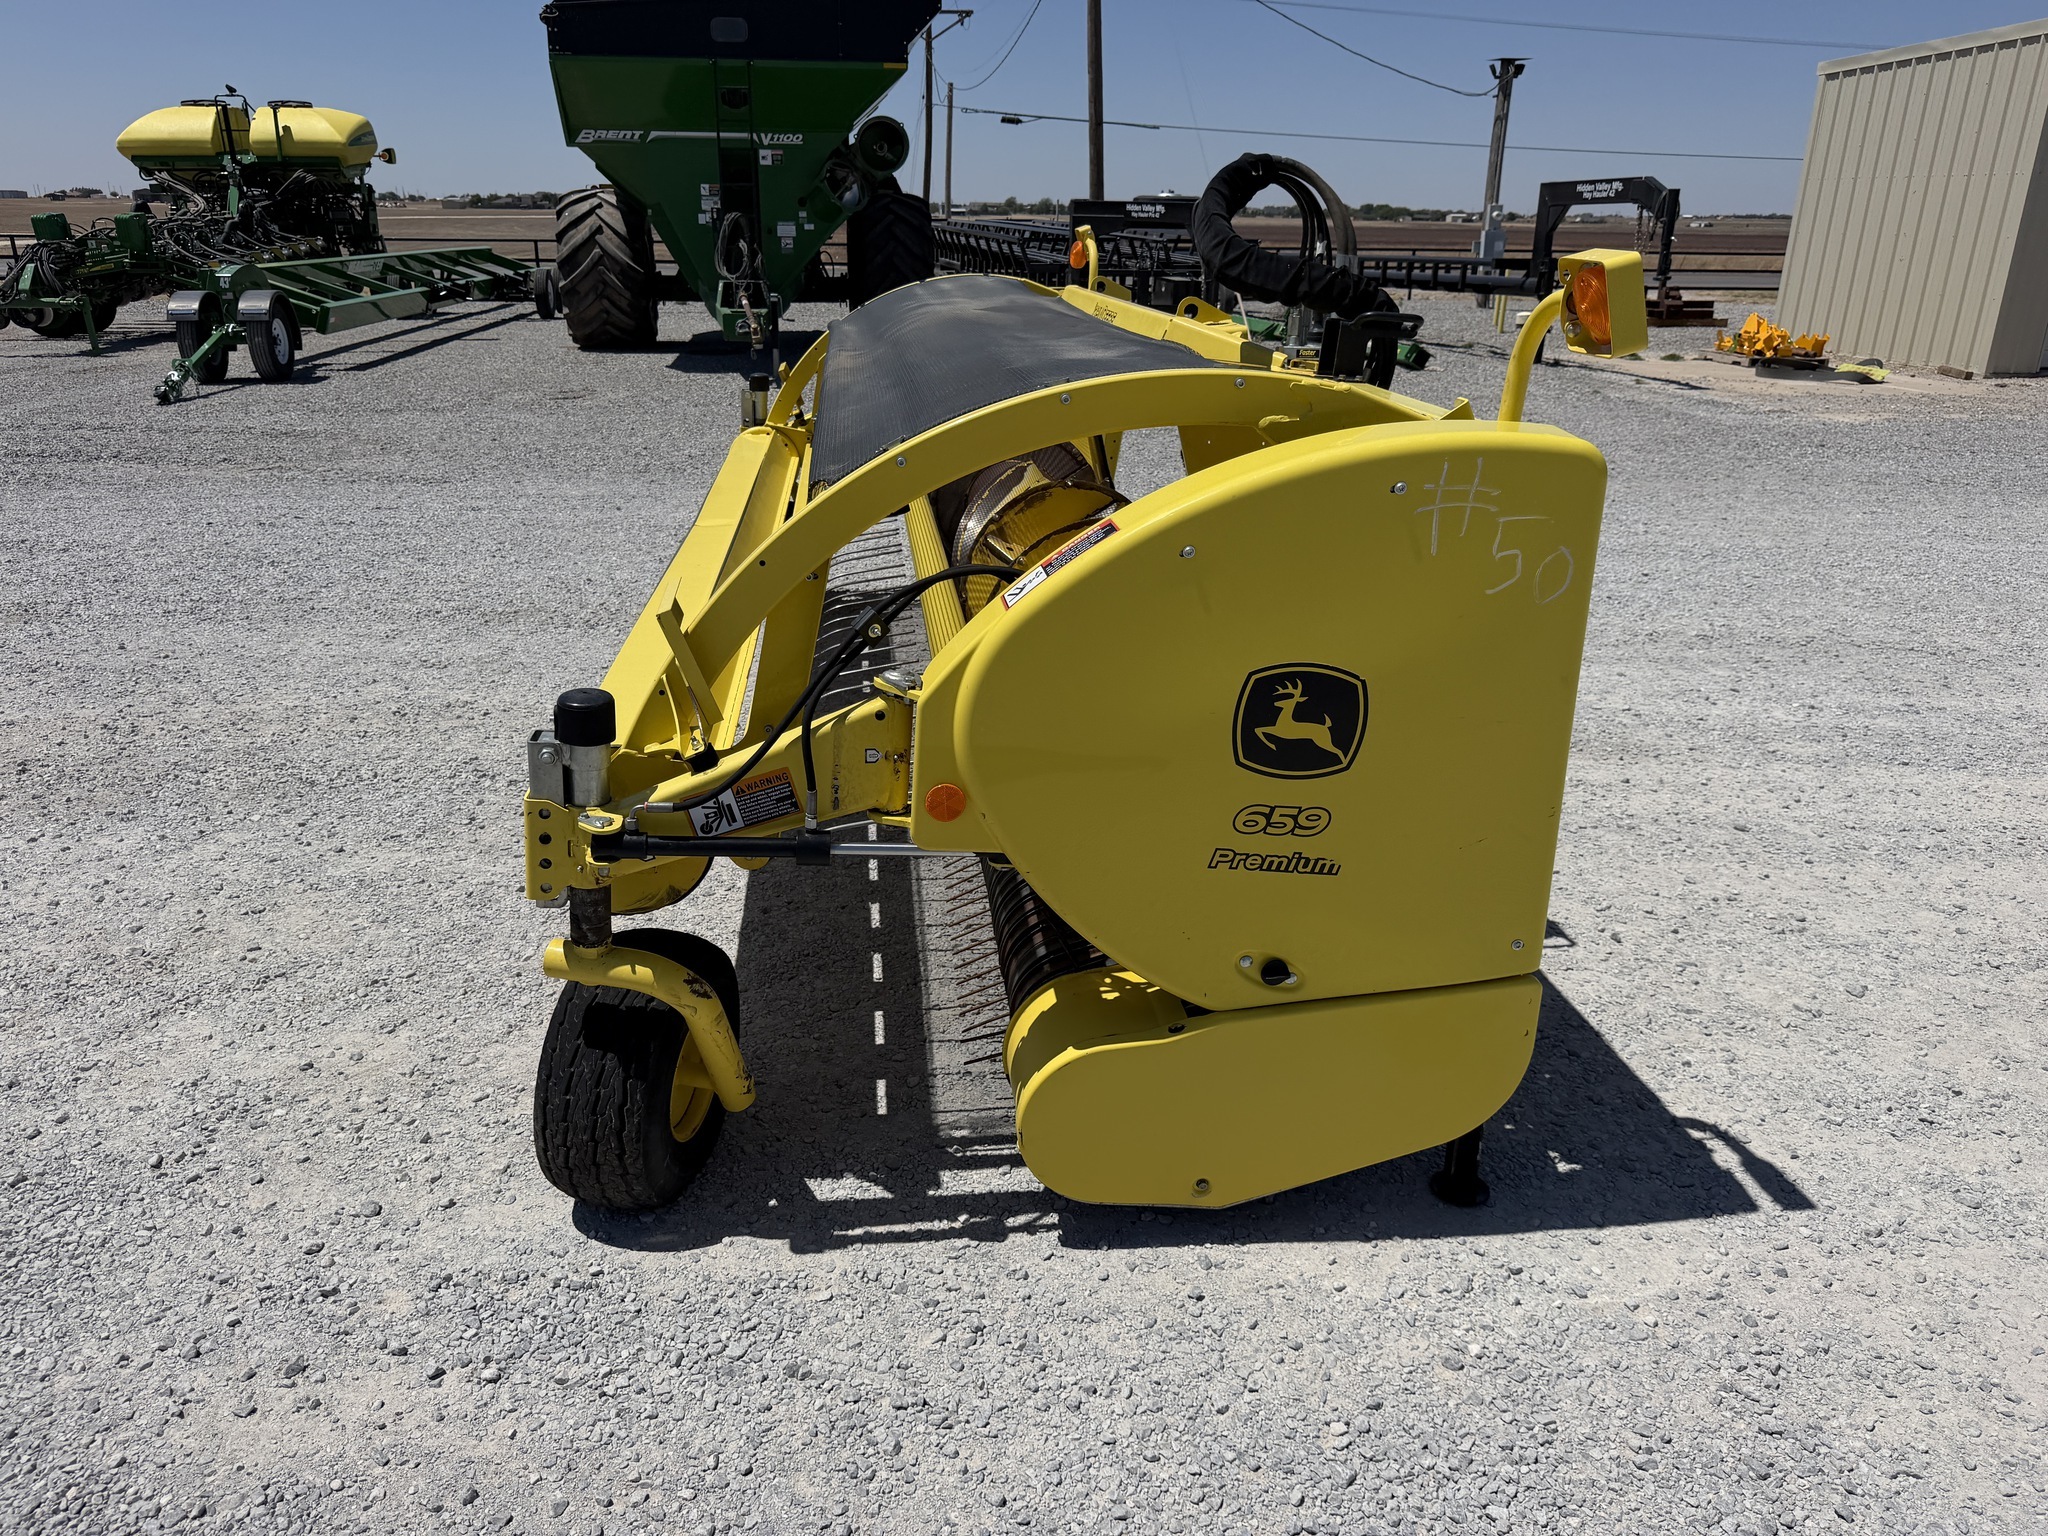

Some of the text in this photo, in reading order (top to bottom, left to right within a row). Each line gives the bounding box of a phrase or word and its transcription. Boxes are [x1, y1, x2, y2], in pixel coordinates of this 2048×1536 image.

[575, 129, 644, 143] BRENT
[760, 133, 803, 145] V1100
[1576, 183, 1595, 192] Hidden
[1595, 182, 1611, 192] Valley
[1126, 203, 1142, 211] Hidden
[1142, 204, 1156, 213] Valley
[744, 772, 788, 791] WARNING
[1232, 804, 1332, 838] 659
[1207, 848, 1341, 876] Premium
